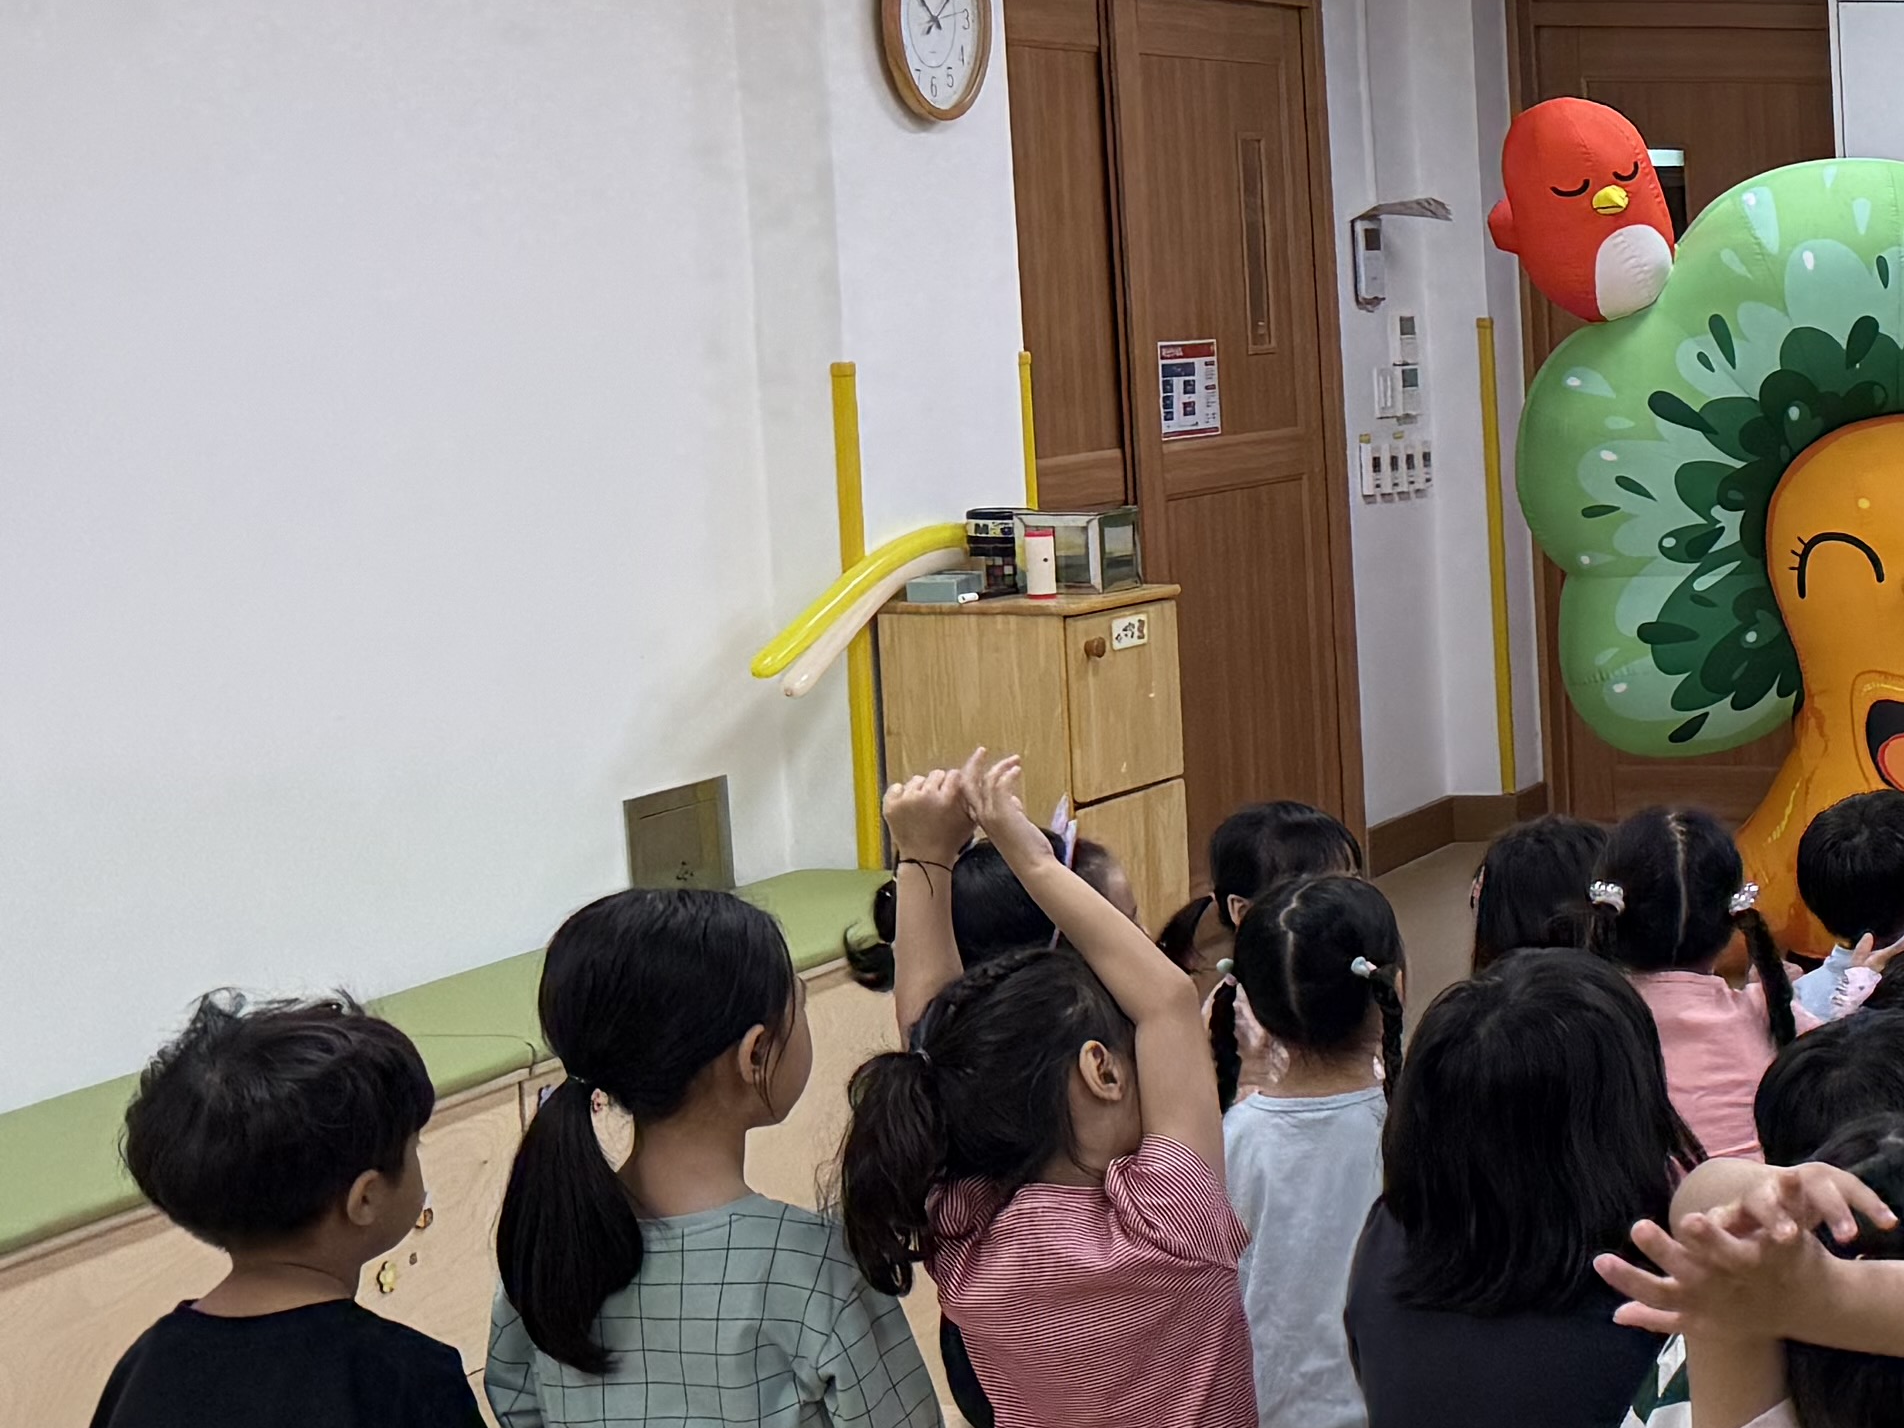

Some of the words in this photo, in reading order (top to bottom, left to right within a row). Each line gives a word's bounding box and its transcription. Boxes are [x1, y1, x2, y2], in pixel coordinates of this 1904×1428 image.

[962, 8, 969, 30] 3
[958, 44, 965, 66] 4
[915, 69, 921, 87] 7
[930, 76, 937, 97] 6
[946, 66, 954, 88] 5
